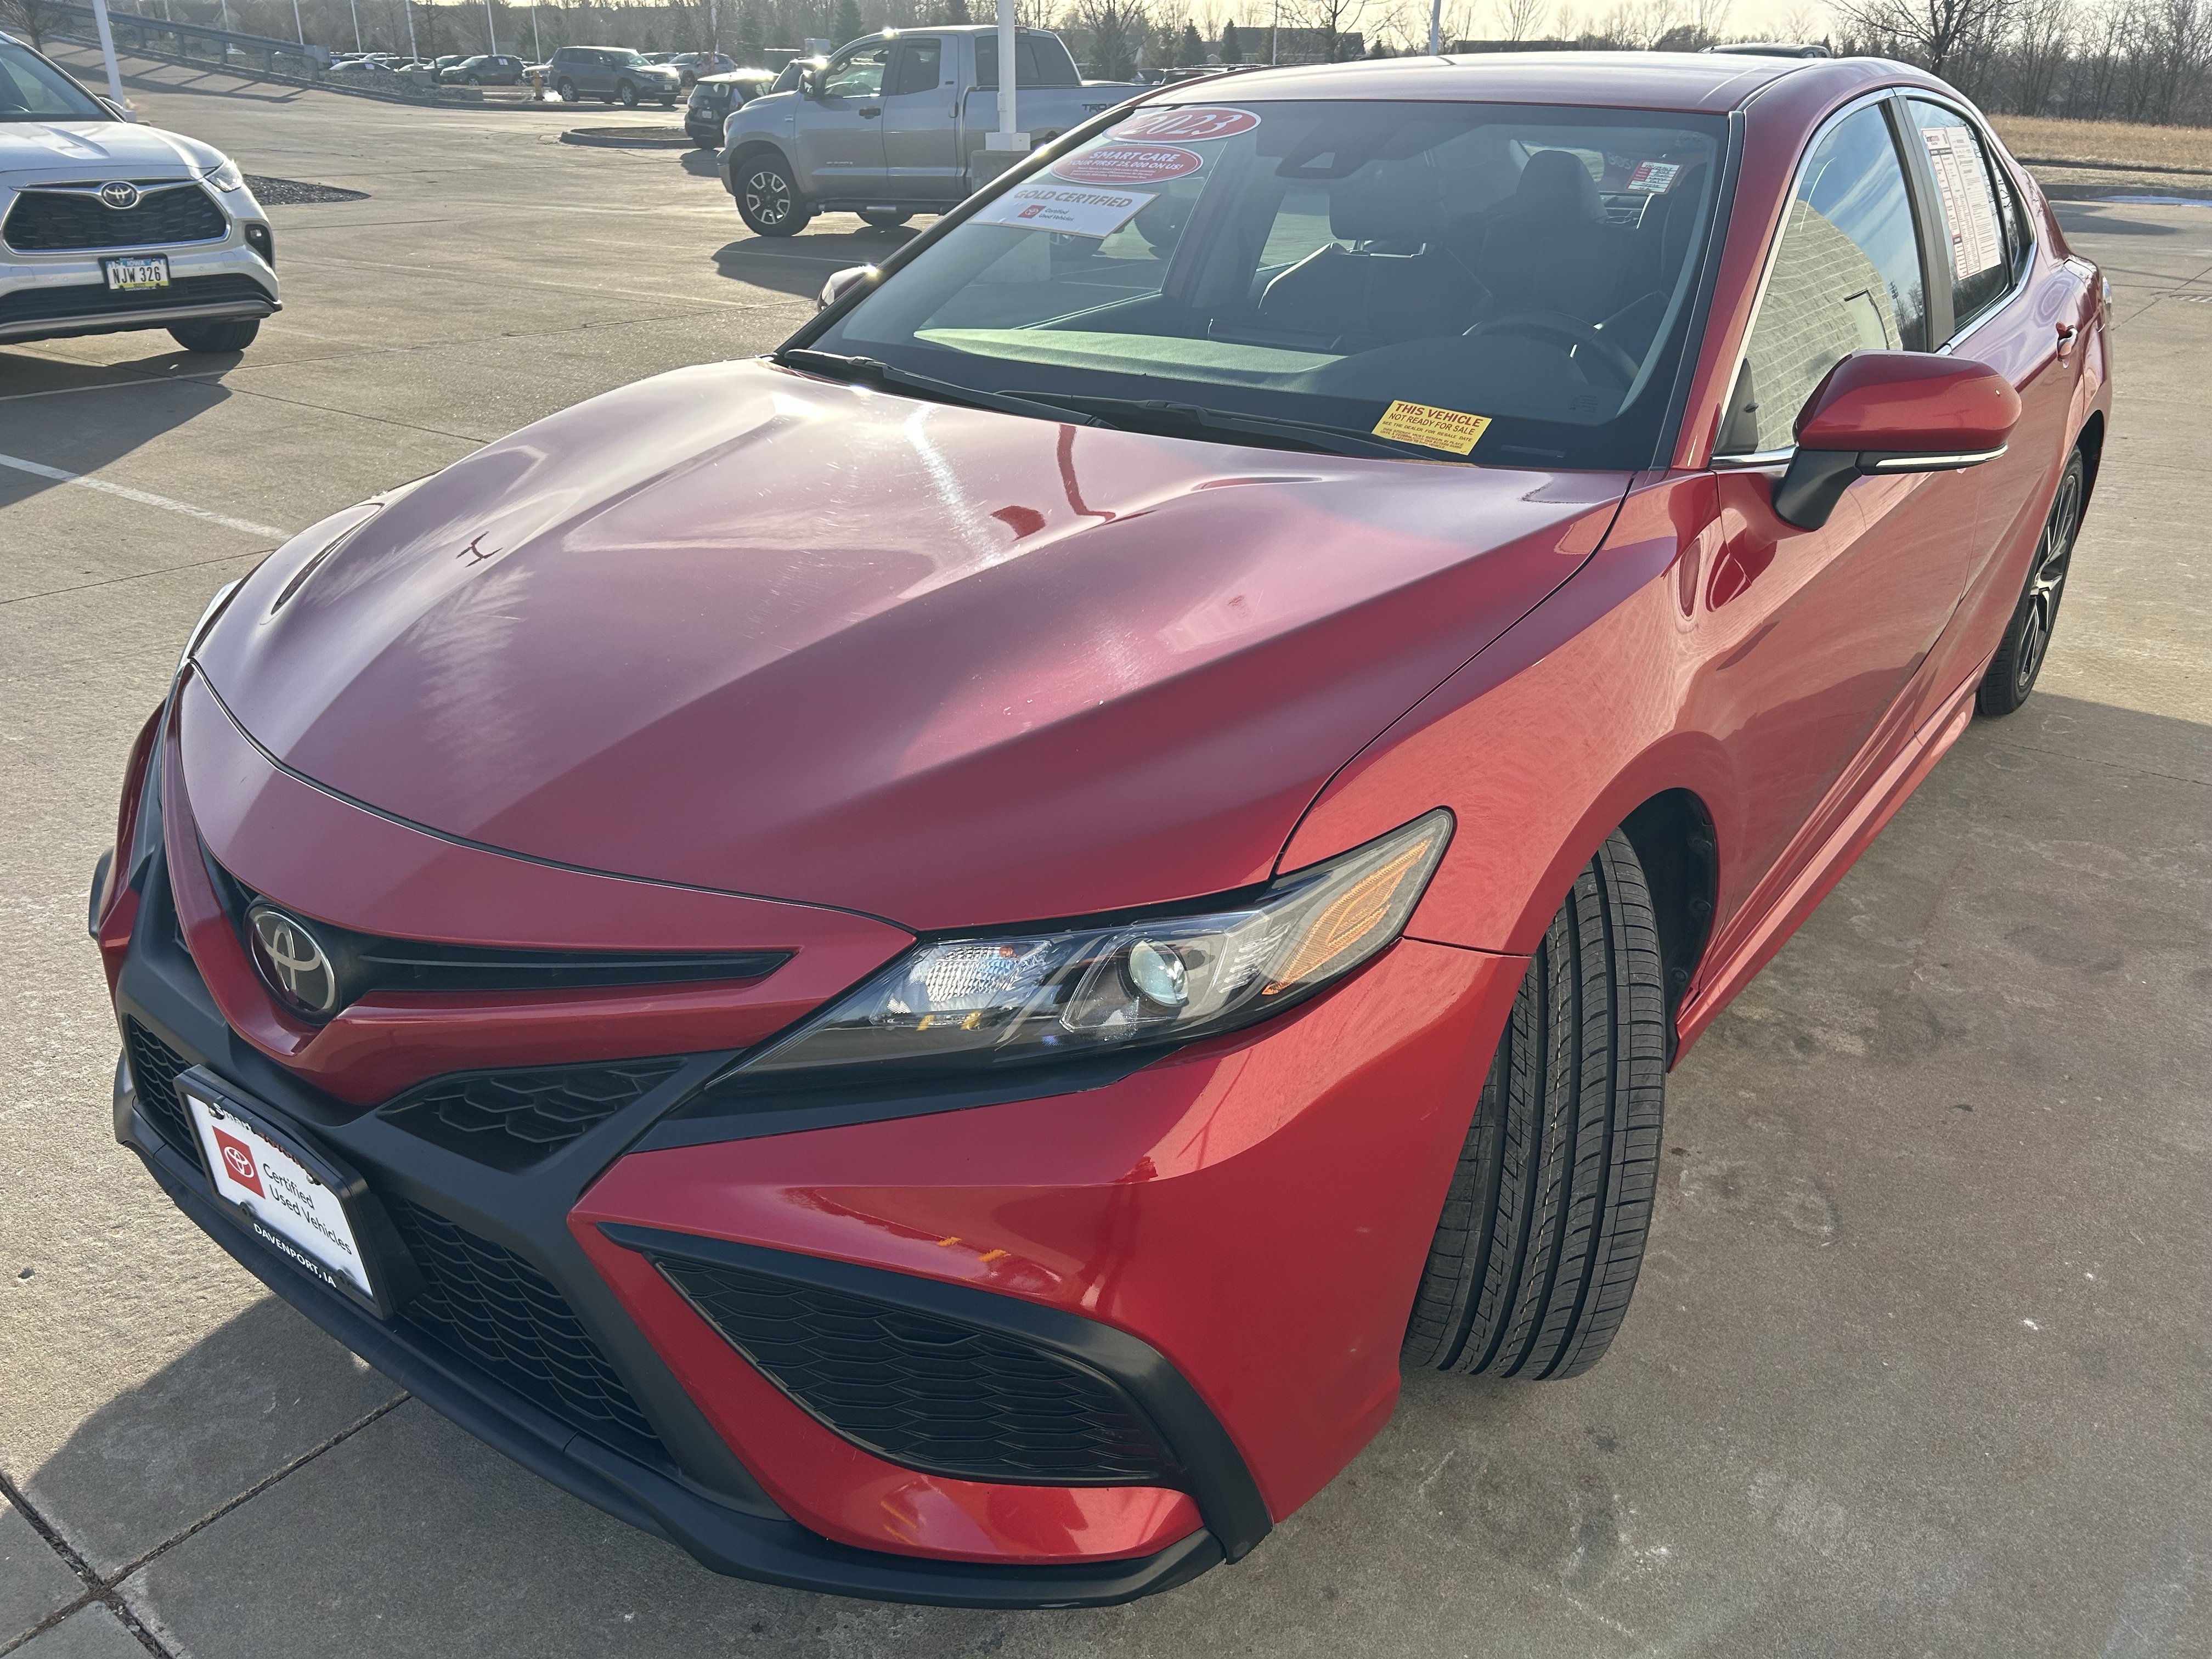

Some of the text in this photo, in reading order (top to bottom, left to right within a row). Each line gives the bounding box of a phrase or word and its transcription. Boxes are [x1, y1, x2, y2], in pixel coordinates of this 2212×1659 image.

[1081, 103, 1107, 112] TRD
[1118, 114, 1243, 136] 2023
[1090, 150, 1181, 162] SMART CARE
[1014, 190, 1133, 207] GOLD CERTIFIED
[112, 266, 161, 284] NJW 326
[1387, 413, 1476, 436] NOT READY FOR SALE
[1395, 403, 1483, 428] THIS VEHICLE
[213, 1102, 252, 1131] Smart
[263, 1163, 314, 1210] Certified
[269, 1183, 353, 1255] Used Vehicles
[253, 1223, 337, 1288] DAVENPORT, IA
